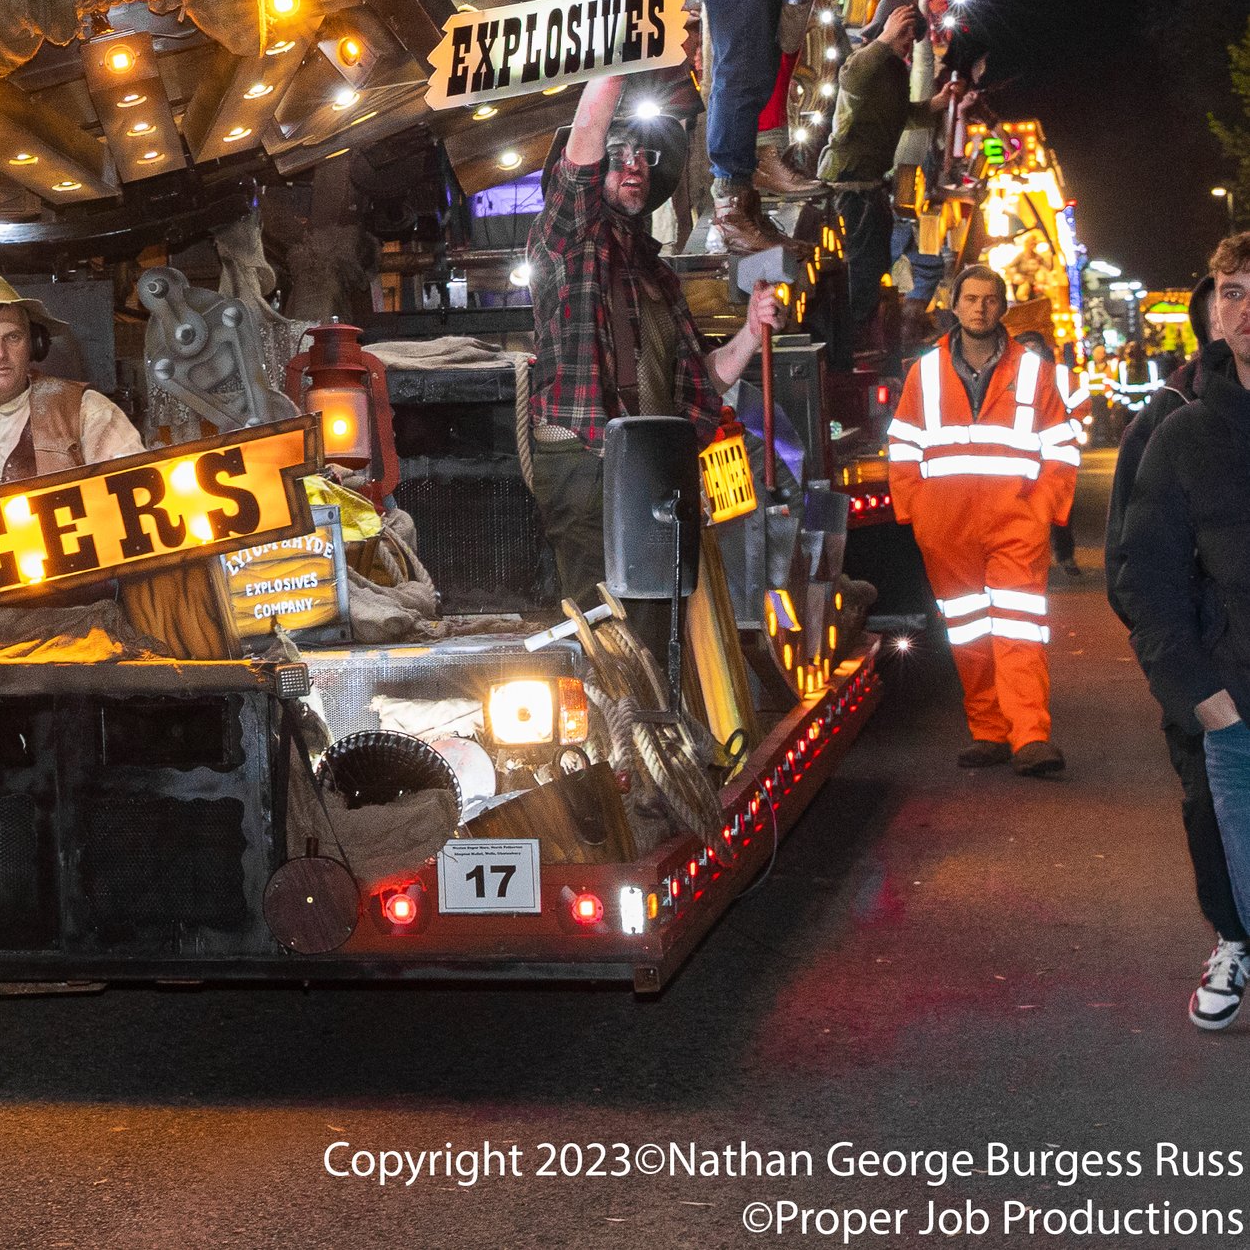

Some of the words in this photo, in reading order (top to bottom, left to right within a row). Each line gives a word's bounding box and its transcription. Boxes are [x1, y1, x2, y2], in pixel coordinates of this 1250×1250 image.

[246, 572, 319, 597] EXPLOSIVES
[254, 598, 313, 619] COMPANY
[465, 864, 517, 898] 17
